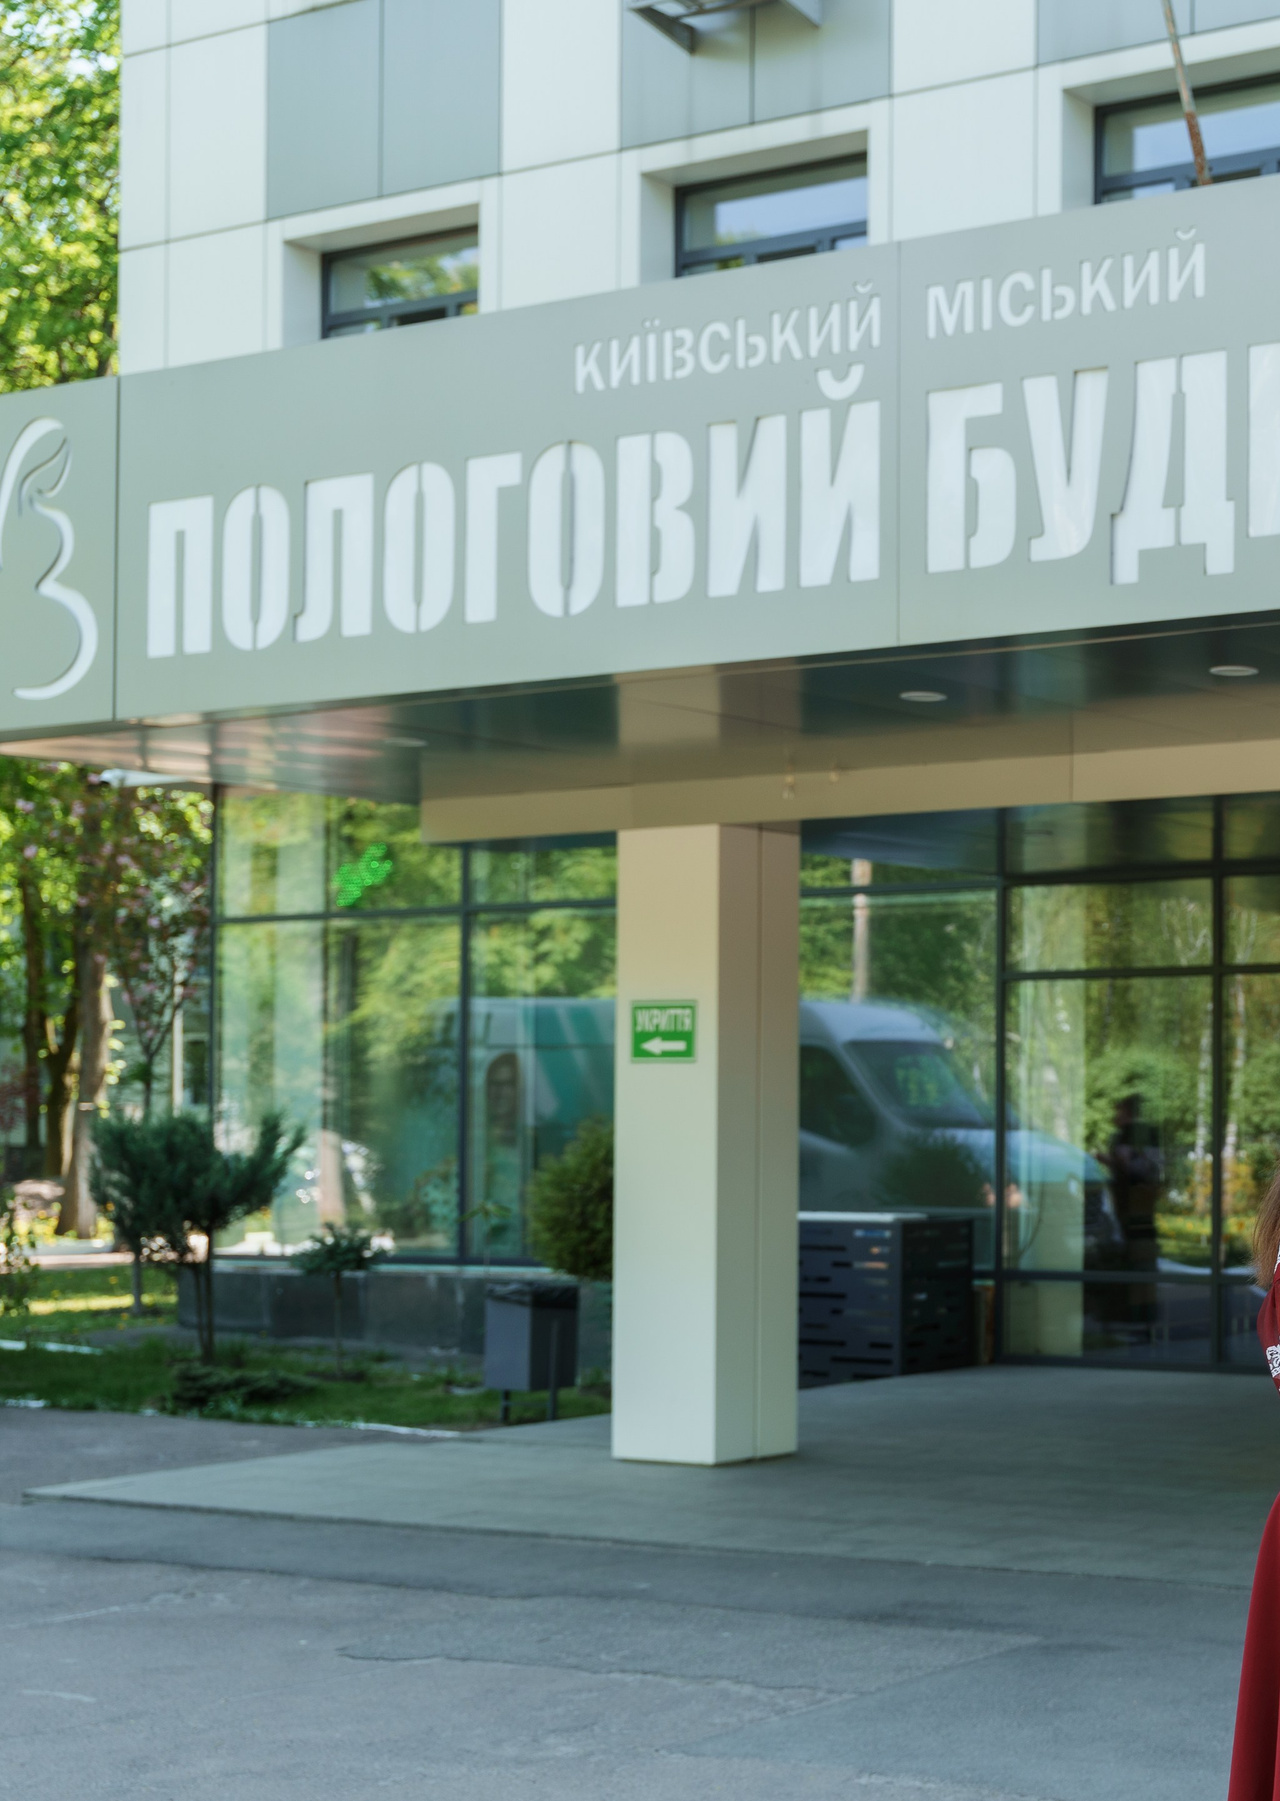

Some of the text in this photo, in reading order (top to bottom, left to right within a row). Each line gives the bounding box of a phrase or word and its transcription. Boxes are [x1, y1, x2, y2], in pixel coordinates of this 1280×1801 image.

[574, 227, 1206, 394] КИЇВСЬКИЙ МІСЬКИЙ
[146, 364, 881, 658] ПОЛОГОВИЙ
